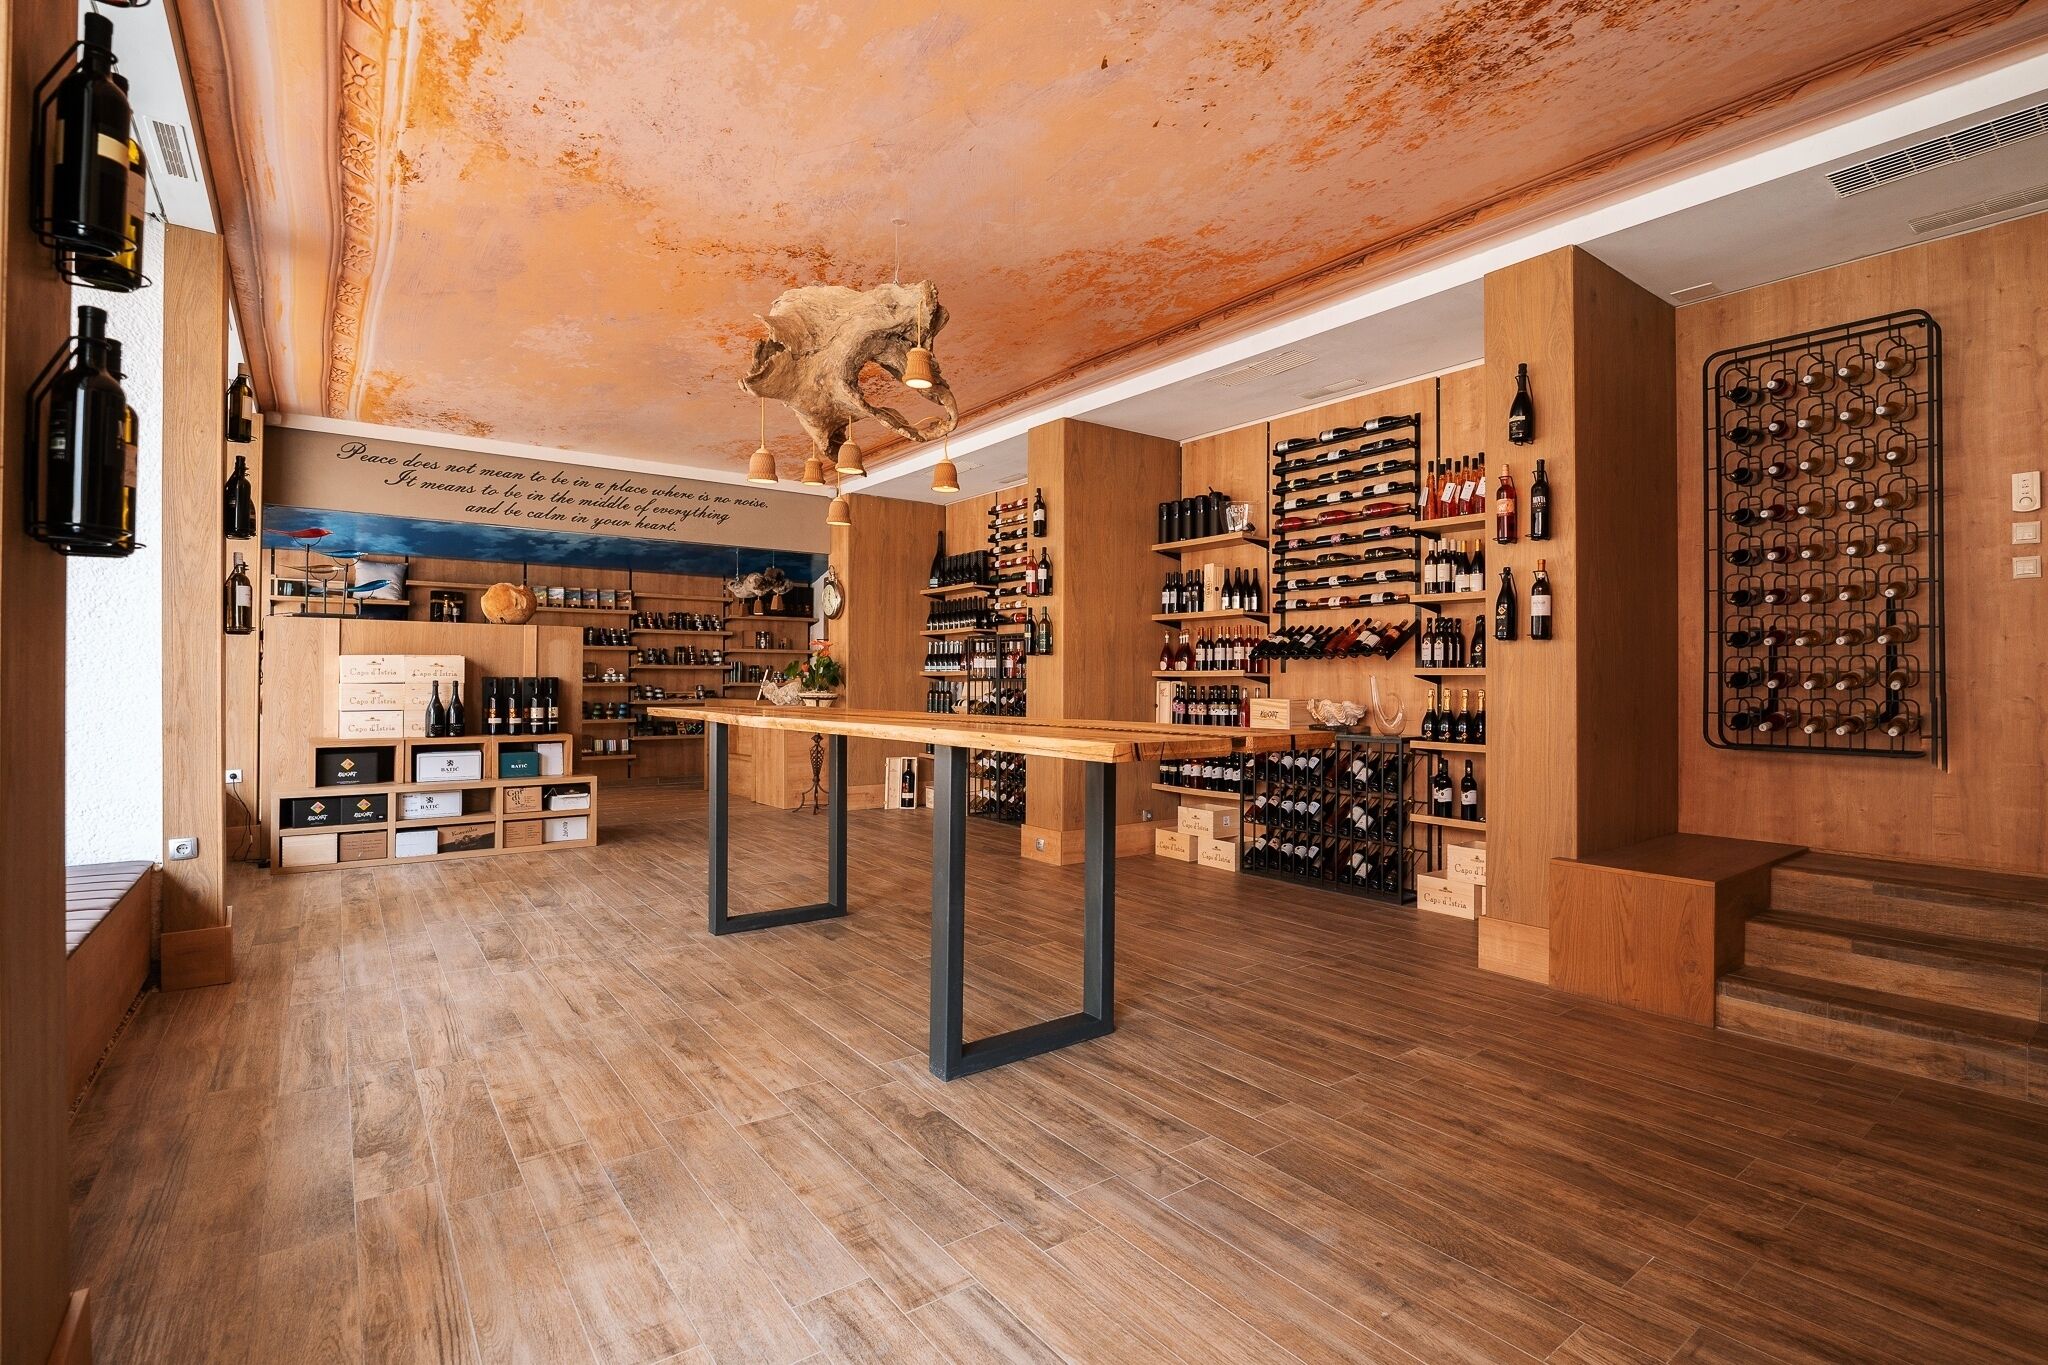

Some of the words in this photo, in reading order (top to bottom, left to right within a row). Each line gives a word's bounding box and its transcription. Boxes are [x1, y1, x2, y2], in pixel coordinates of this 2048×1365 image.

[336, 441, 398, 465] Peace
[402, 453, 440, 470] does
[444, 463, 477, 474] not
[480, 469, 525, 480] mean
[530, 470, 546, 483] to
[551, 470, 571, 486] be
[573, 476, 590, 488] in
[594, 481, 605, 490] a
[605, 479, 648, 496] place
[651, 485, 694, 500] where
[698, 492, 711, 502] is
[714, 496, 731, 504] no
[733, 497, 769, 509] noise.
[384, 469, 417, 487] It
[420, 480, 476, 495] means
[481, 483, 499, 496] to
[503, 484, 522, 499] be
[526, 488, 546, 502] in
[550, 490, 574, 504] the
[579, 495, 631, 511] middle
[634, 499, 655, 518] of
[652, 504, 731, 525] everything
[464, 501, 505, 515] and
[504, 502, 523, 517] be
[526, 509, 567, 522] calm
[571, 512, 589, 523] in
[590, 518, 631, 530] your
[635, 515, 677, 532] heart.
[350, 668, 369, 677] Capo
[413, 669, 431, 678] Capo
[349, 696, 368, 705] Capo
[348, 723, 368, 733] Capo
[1454, 863, 1473, 875] Capo
